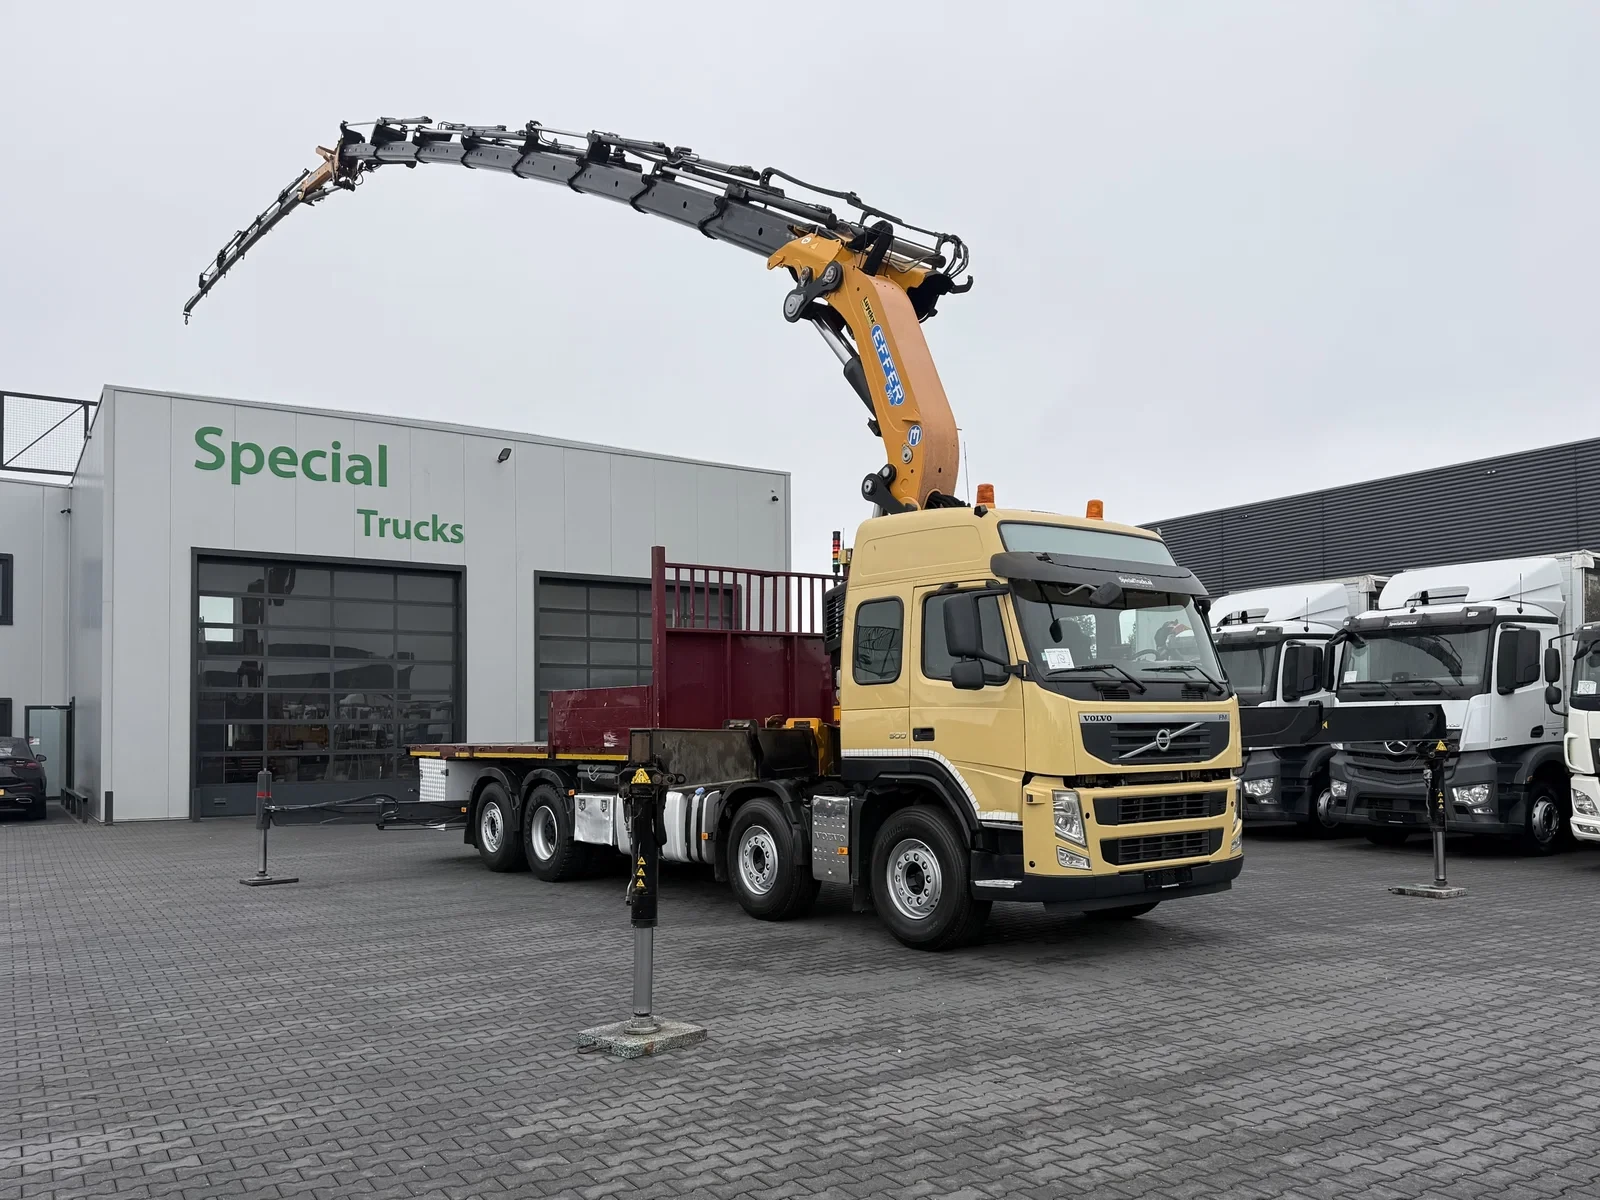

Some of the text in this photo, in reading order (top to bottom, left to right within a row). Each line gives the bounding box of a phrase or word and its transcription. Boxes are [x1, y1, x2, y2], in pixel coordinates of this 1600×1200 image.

[873, 329, 904, 403] EFFER
[194, 426, 388, 487] Special
[356, 508, 464, 544] Trucks
[814, 831, 846, 842] VOLVO
